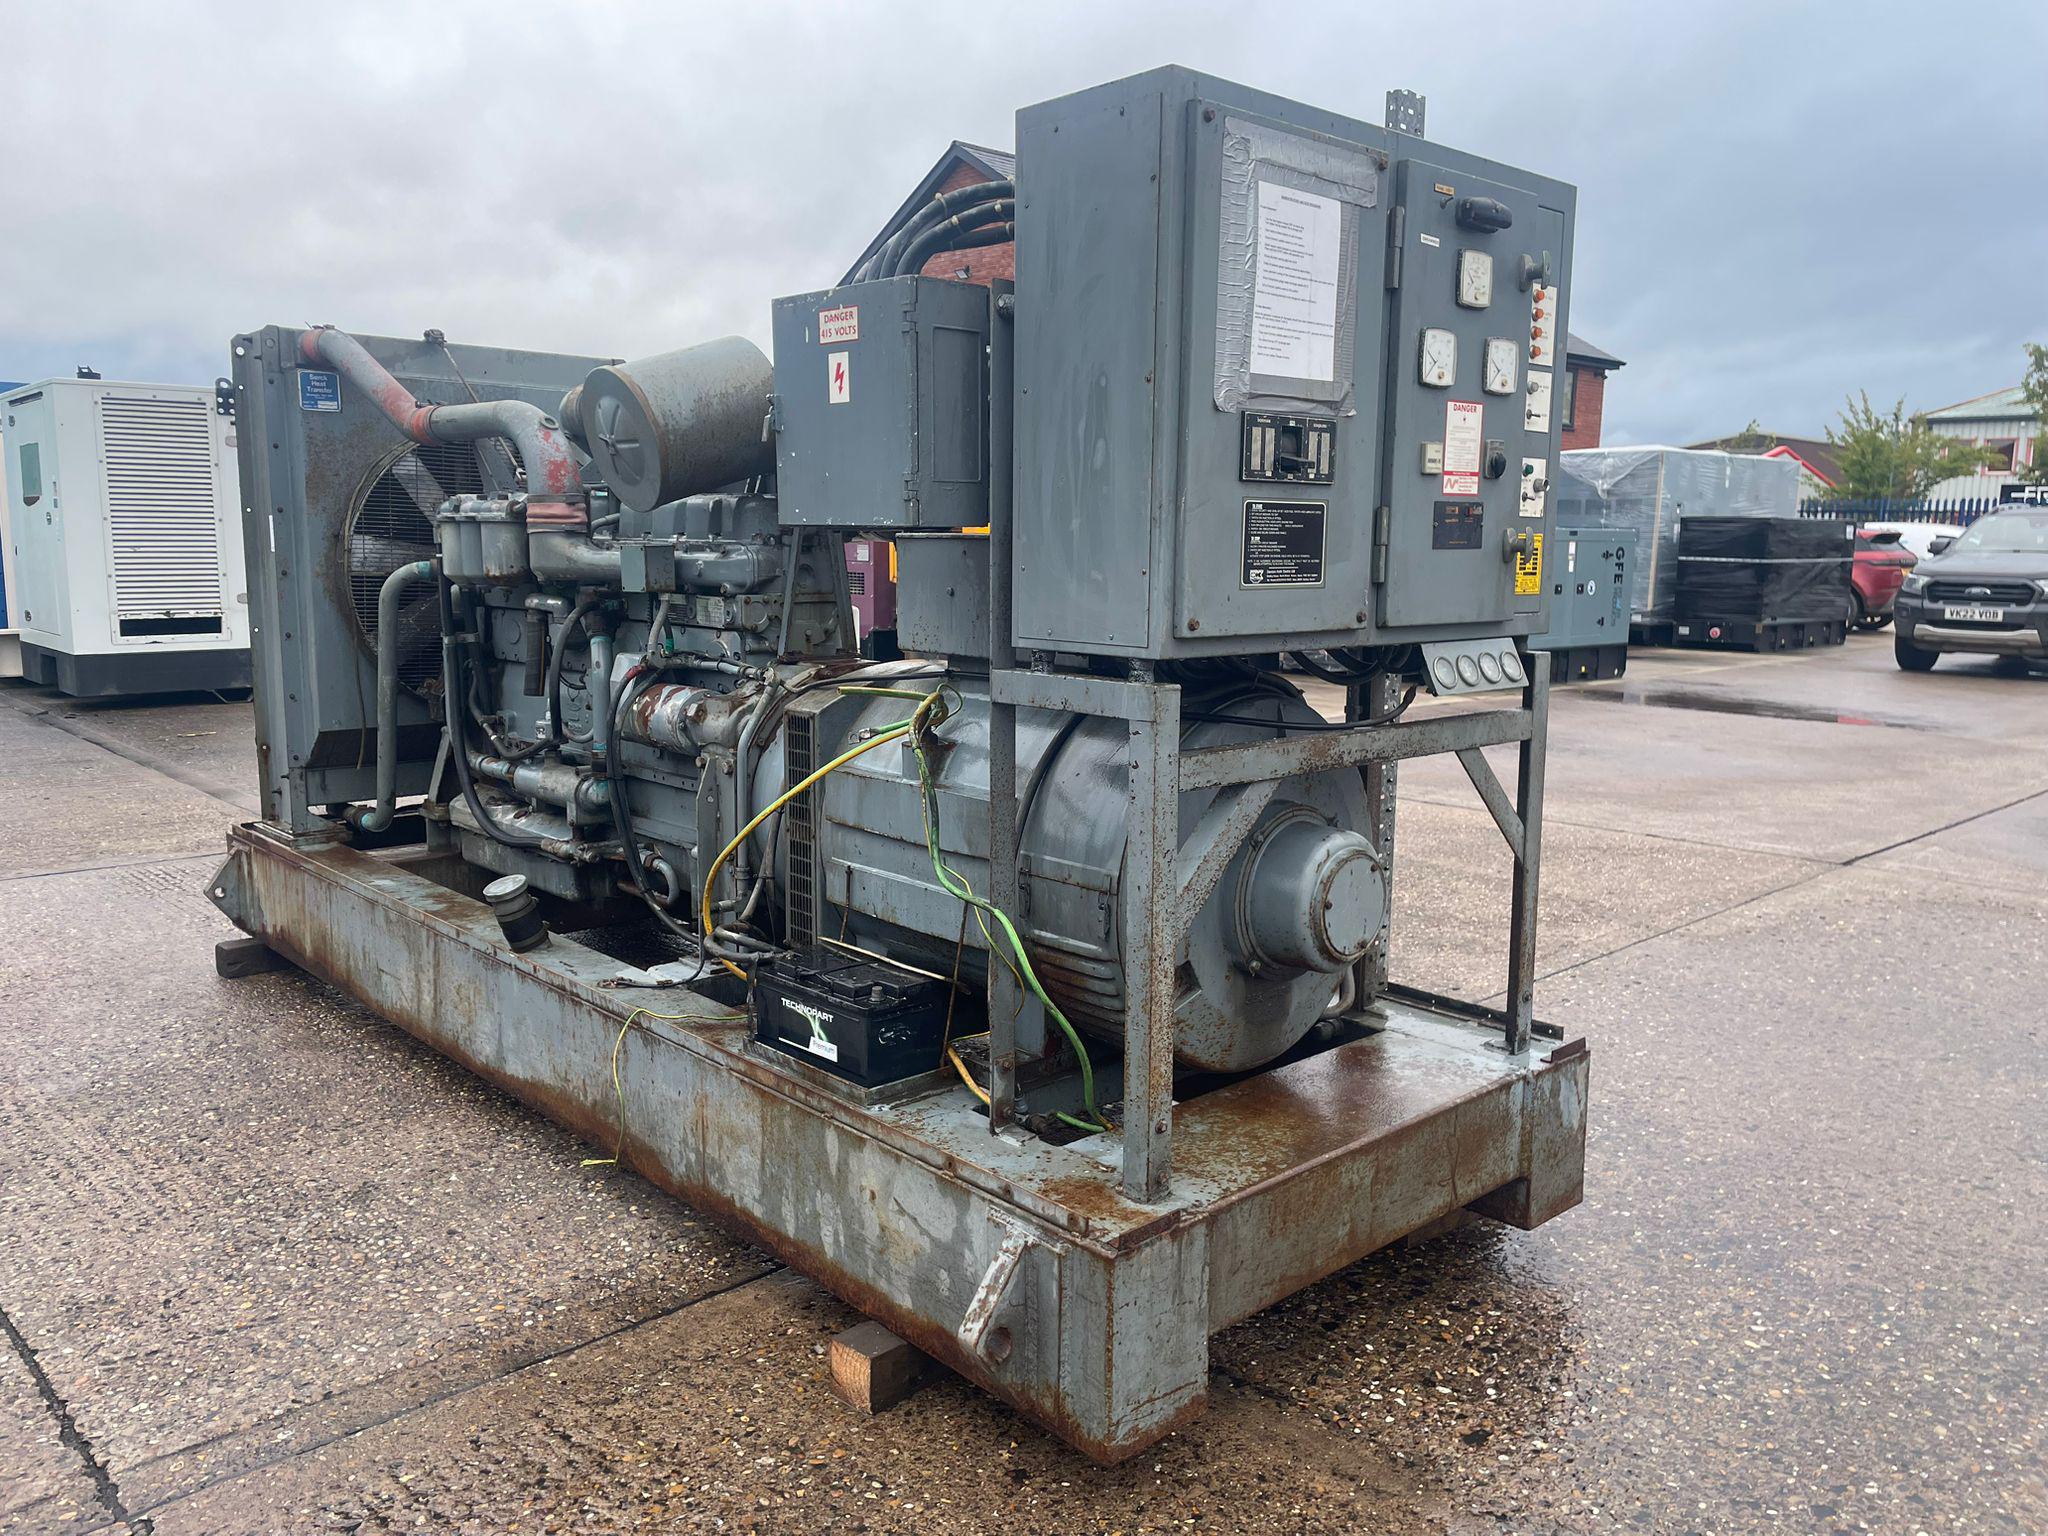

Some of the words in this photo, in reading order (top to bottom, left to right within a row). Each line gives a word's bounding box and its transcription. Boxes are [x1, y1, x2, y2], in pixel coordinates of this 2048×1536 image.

[824, 311, 854, 324] DANGER
[821, 329, 832, 339] 415
[834, 325, 857, 336] VOLTS
[1453, 403, 1477, 413] DANGER
[1614, 546, 1625, 584] GFE
[1949, 608, 1974, 619] VK22
[780, 997, 834, 1023] TECHNOPART
